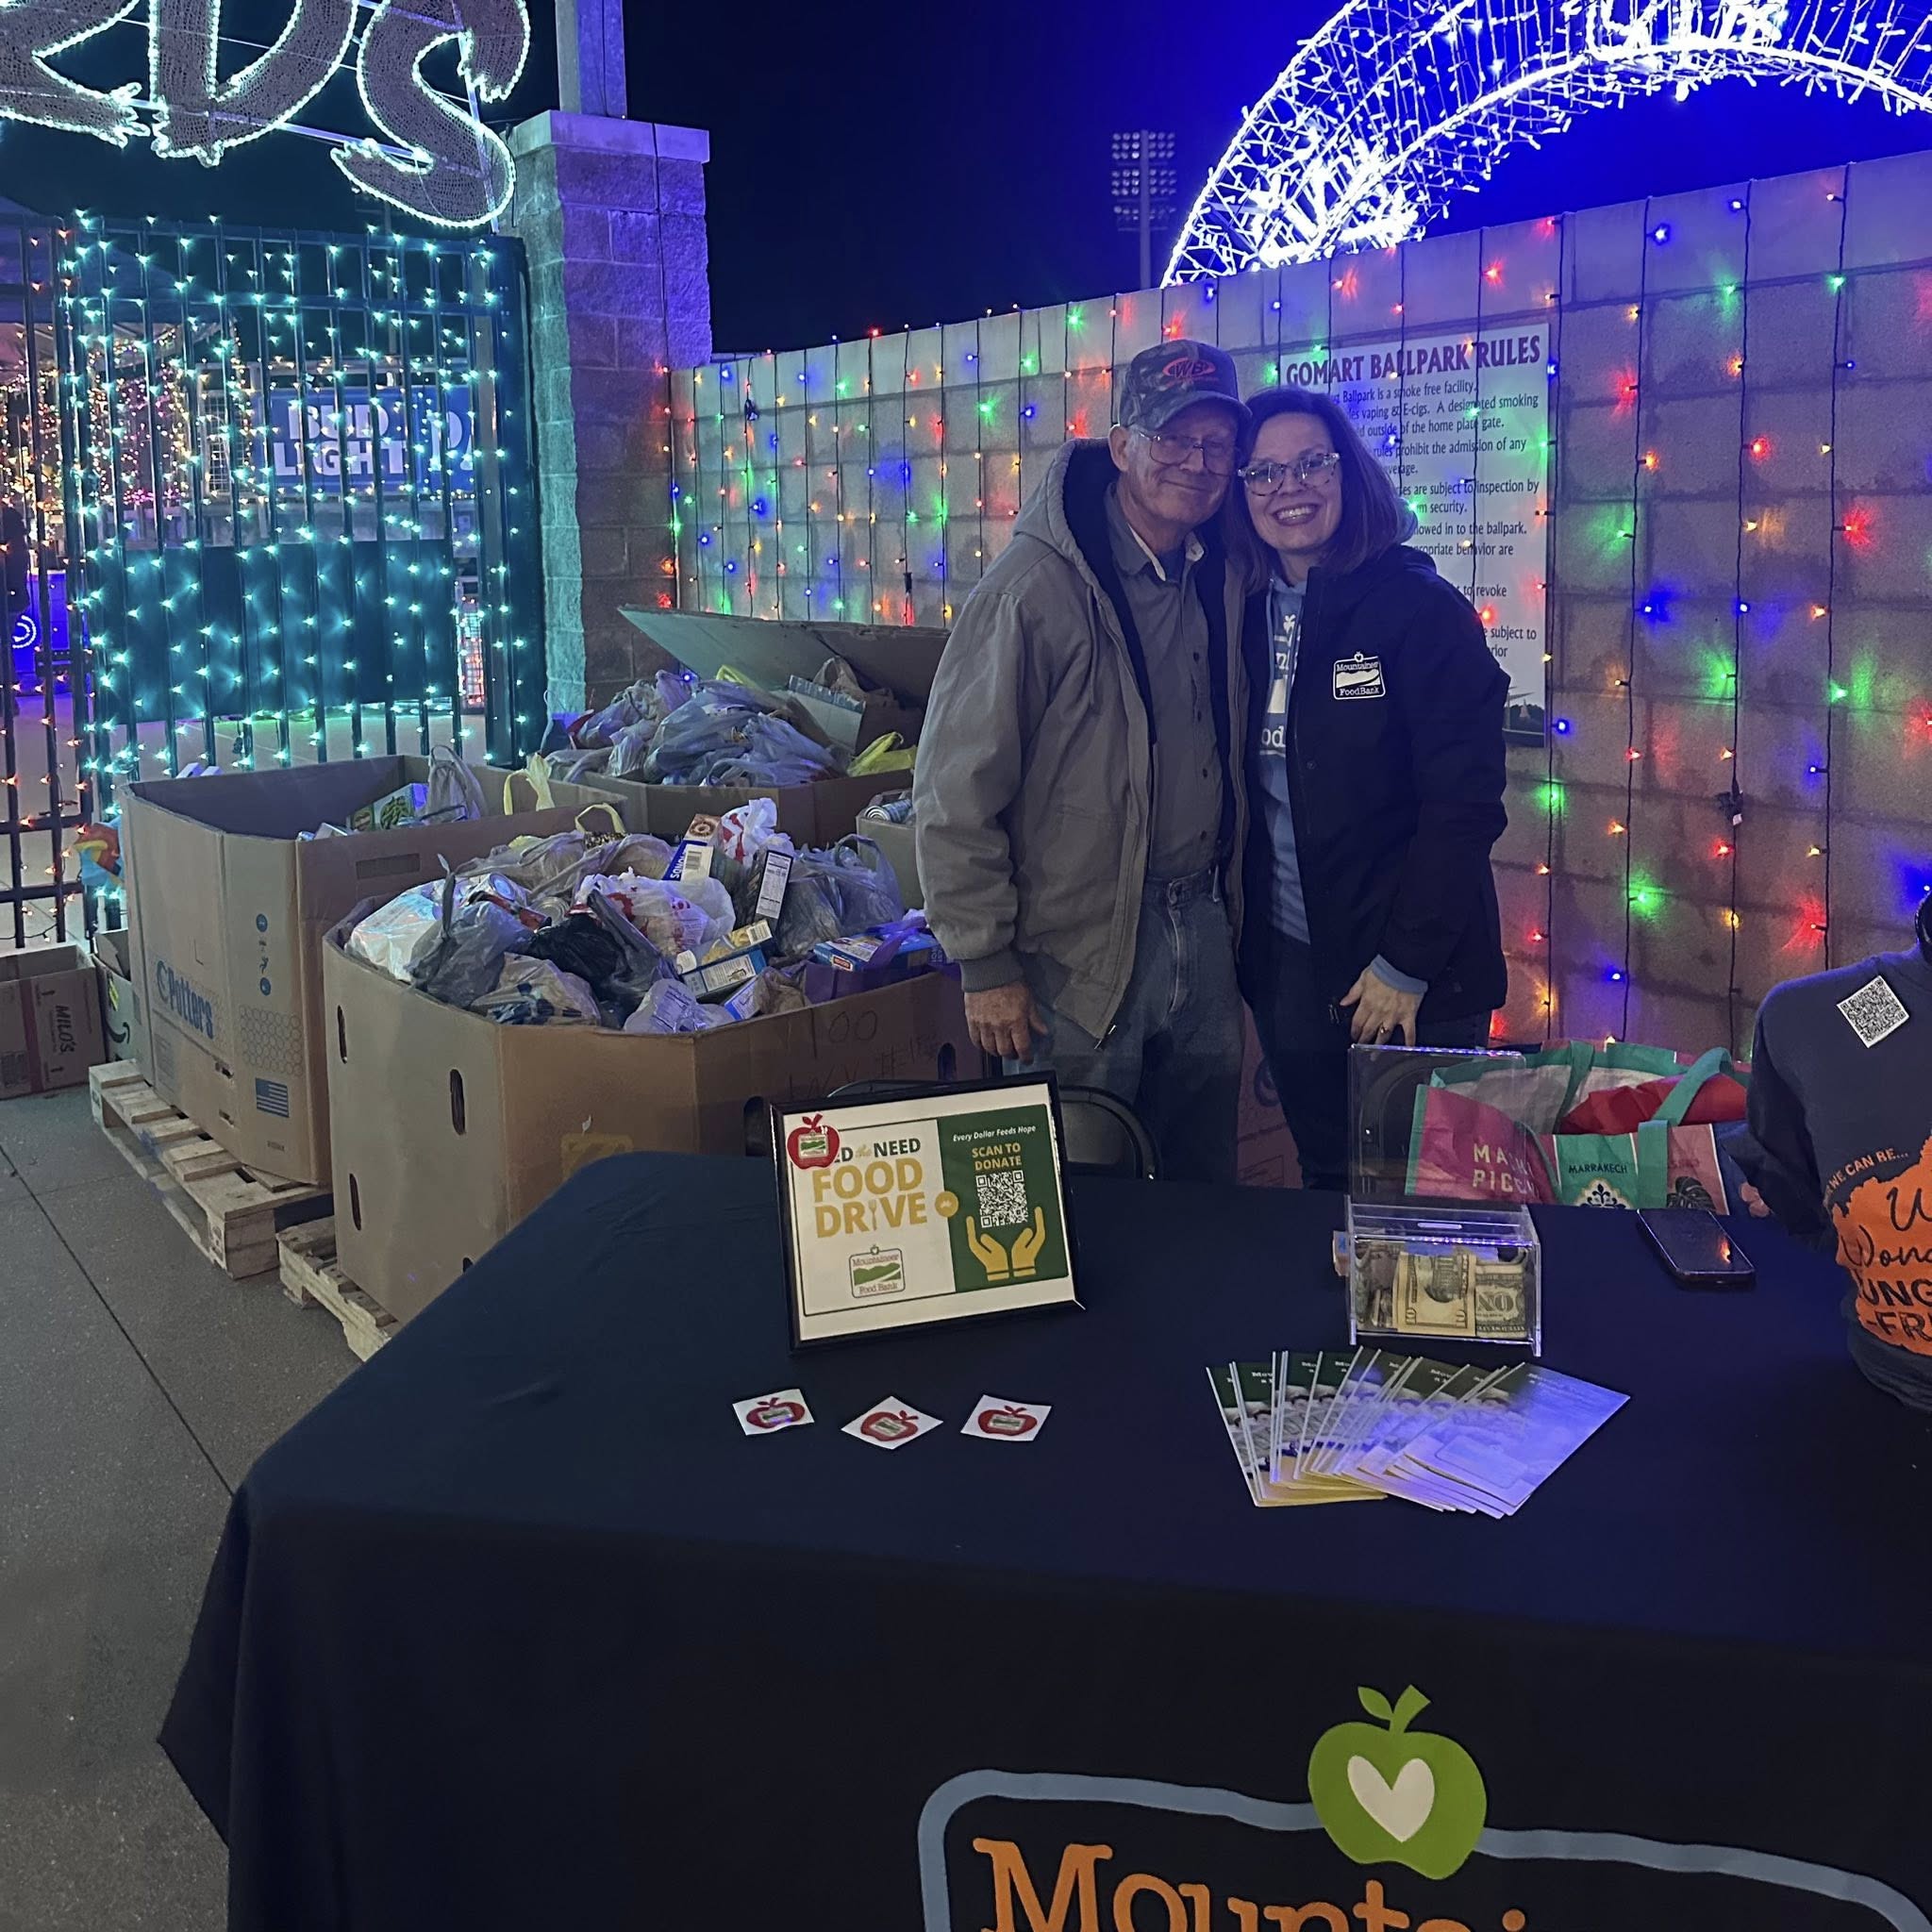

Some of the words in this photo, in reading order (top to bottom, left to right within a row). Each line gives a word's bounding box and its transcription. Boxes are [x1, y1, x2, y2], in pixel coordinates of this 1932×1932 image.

[1286, 356, 1364, 386] GOMART
[1371, 342, 1470, 379] BALLPARK
[1477, 335, 1541, 369] RULES
[1342, 388, 1375, 404] Ballpark
[1377, 387, 1384, 400] is
[1386, 390, 1391, 399] a
[1393, 385, 1421, 398] smoke
[1424, 382, 1441, 396] free
[1444, 380, 1477, 394] facility.
[1361, 405, 1389, 421] vaping
[1437, 401, 1444, 413] A
[1499, 393, 1539, 408] smoking
[1367, 423, 1397, 436] outside
[1401, 421, 1410, 434] of
[1411, 421, 1426, 433] the
[1428, 420, 1453, 432] home
[1481, 417, 1505, 430] gate.
[1395, 440, 1429, 458] prohibit
[1432, 440, 1445, 453] the
[1449, 438, 1493, 454] admission
[1496, 437, 1507, 450] of
[1509, 439, 1526, 452] any
[1414, 484, 1428, 495] are
[1430, 481, 1461, 498] subject
[1463, 482, 1474, 494] to
[1476, 480, 1524, 496] inspection
[1526, 478, 1540, 494] by
[1429, 499, 1468, 515] security.
[1444, 523, 1454, 535] in
[1457, 525, 1466, 535] to
[1487, 521, 1527, 537] ballpark.
[1498, 545, 1514, 556] are
[1463, 586, 1474, 597] to
[1475, 584, 1507, 597] revoke
[1491, 625, 1524, 641] subject
[1526, 628, 1537, 641] to
[55, 1005, 75, 1054] MILO'S
[953, 1133, 973, 1142] Every
[974, 1130, 995, 1140] Dollar
[996, 1126, 1016, 1136] Feeds
[1018, 1125, 1036, 1134] Hope
[873, 1138, 921, 1158] NEED
[972, 1144, 1003, 1158] SCAN
[1005, 1141, 1021, 1154] TO
[974, 1156, 1022, 1170] DONATE
[1568, 1163, 1628, 1174] MARRAKECH
[1828, 1171, 1846, 1189] WE
[1844, 1155, 1874, 1176] CAN
[811, 1158, 923, 1203] FOOD
